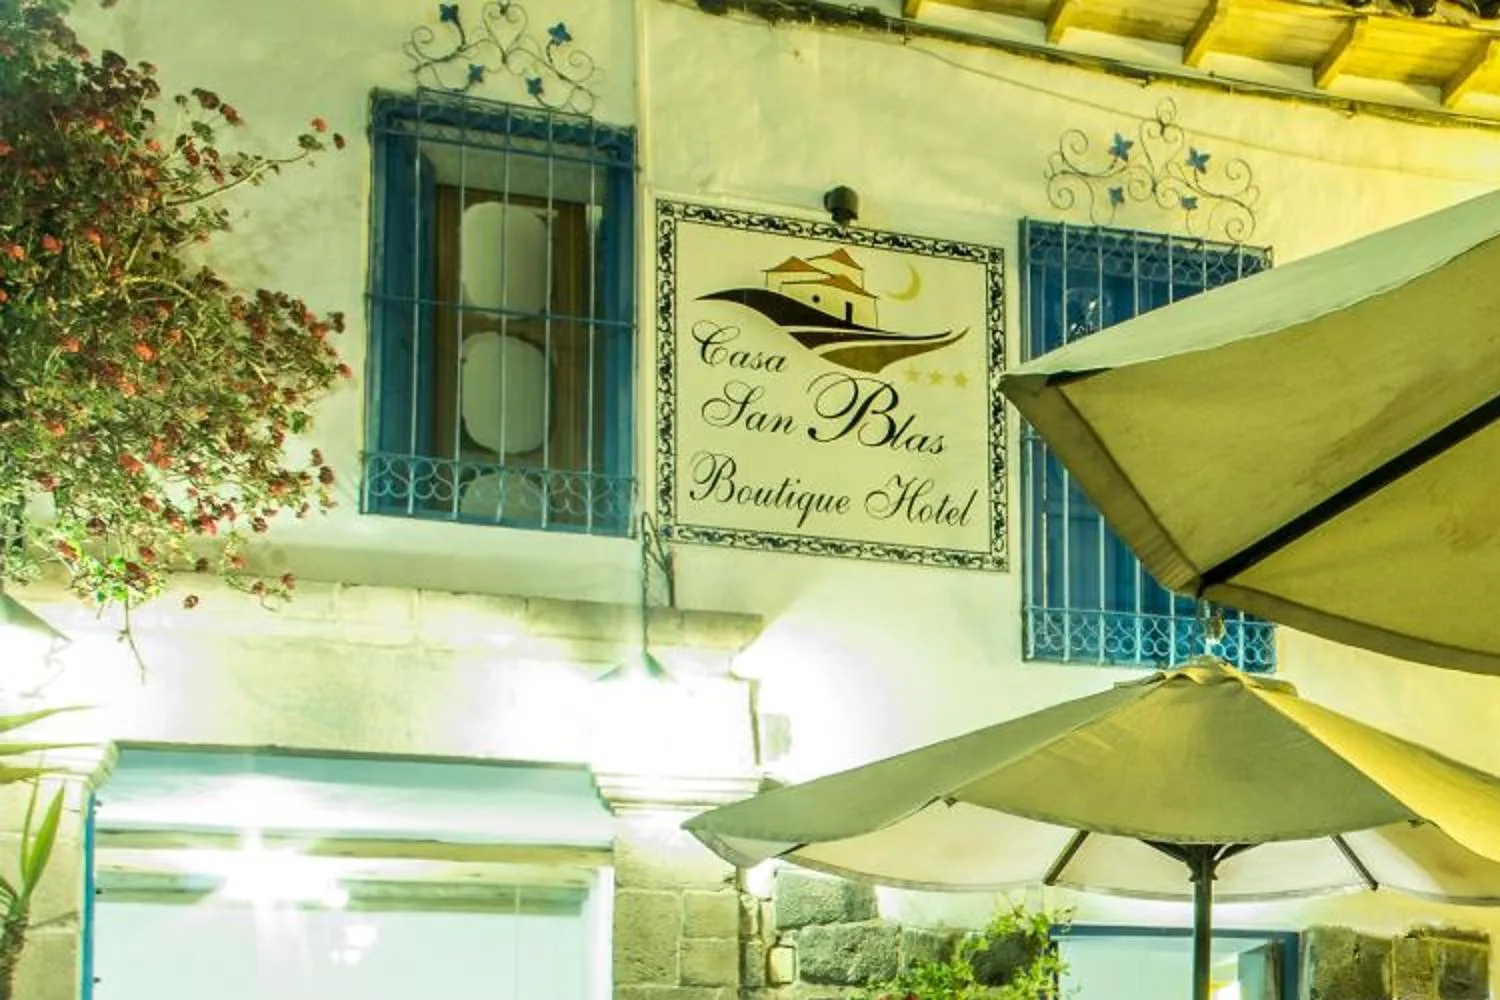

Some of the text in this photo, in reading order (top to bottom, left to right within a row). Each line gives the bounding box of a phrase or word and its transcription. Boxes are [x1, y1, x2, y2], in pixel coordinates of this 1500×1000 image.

[691, 319, 788, 373] Casa
[701, 371, 946, 454] San Blas
[689, 450, 979, 529] Boutique Hotel
